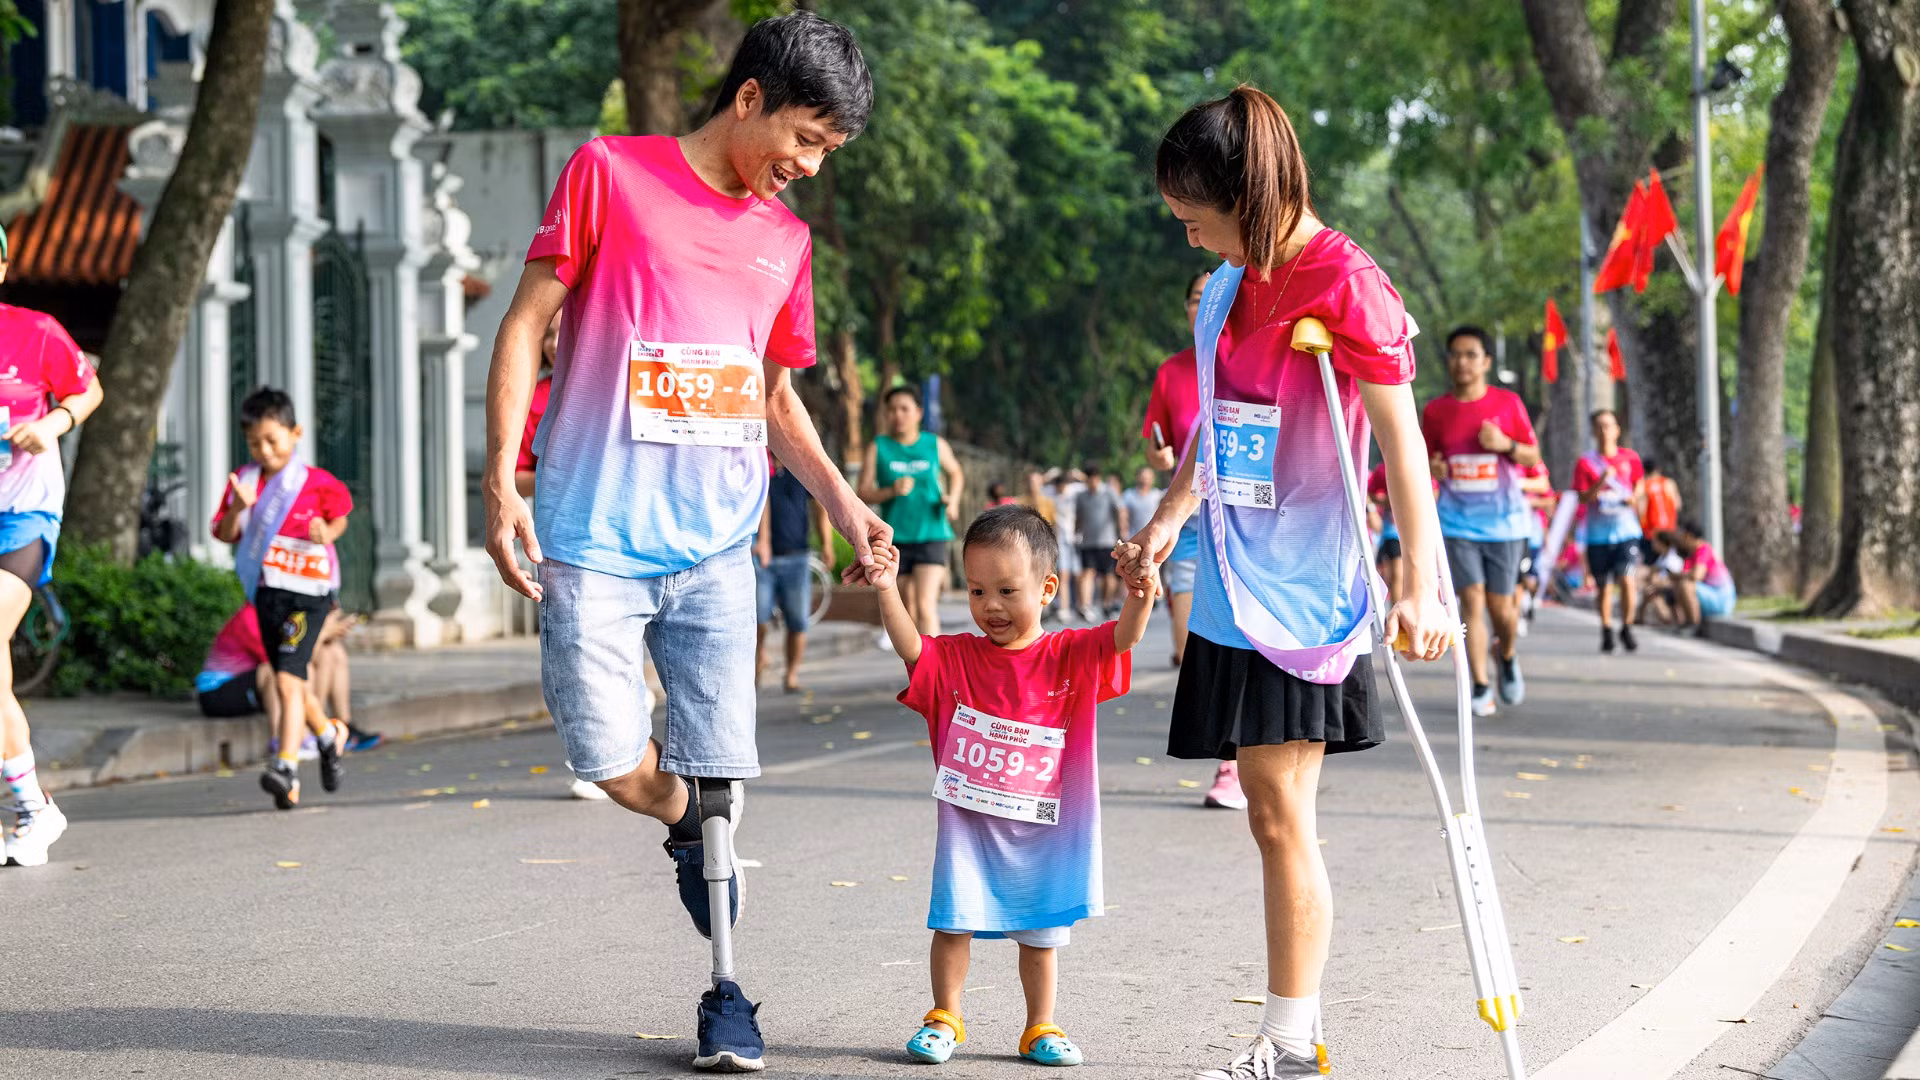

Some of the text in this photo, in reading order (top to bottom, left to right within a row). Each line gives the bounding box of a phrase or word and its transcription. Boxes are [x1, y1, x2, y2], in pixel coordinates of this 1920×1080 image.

[680, 347, 703, 357] CÙNG
[1218, 403, 1229, 413] CÙNG
[1206, 451, 1222, 545] EKIDEN
[990, 721, 1013, 733] CÙNG
[1013, 726, 1030, 737] BẠN
[989, 732, 1028, 744] HẠNH PHÚC
